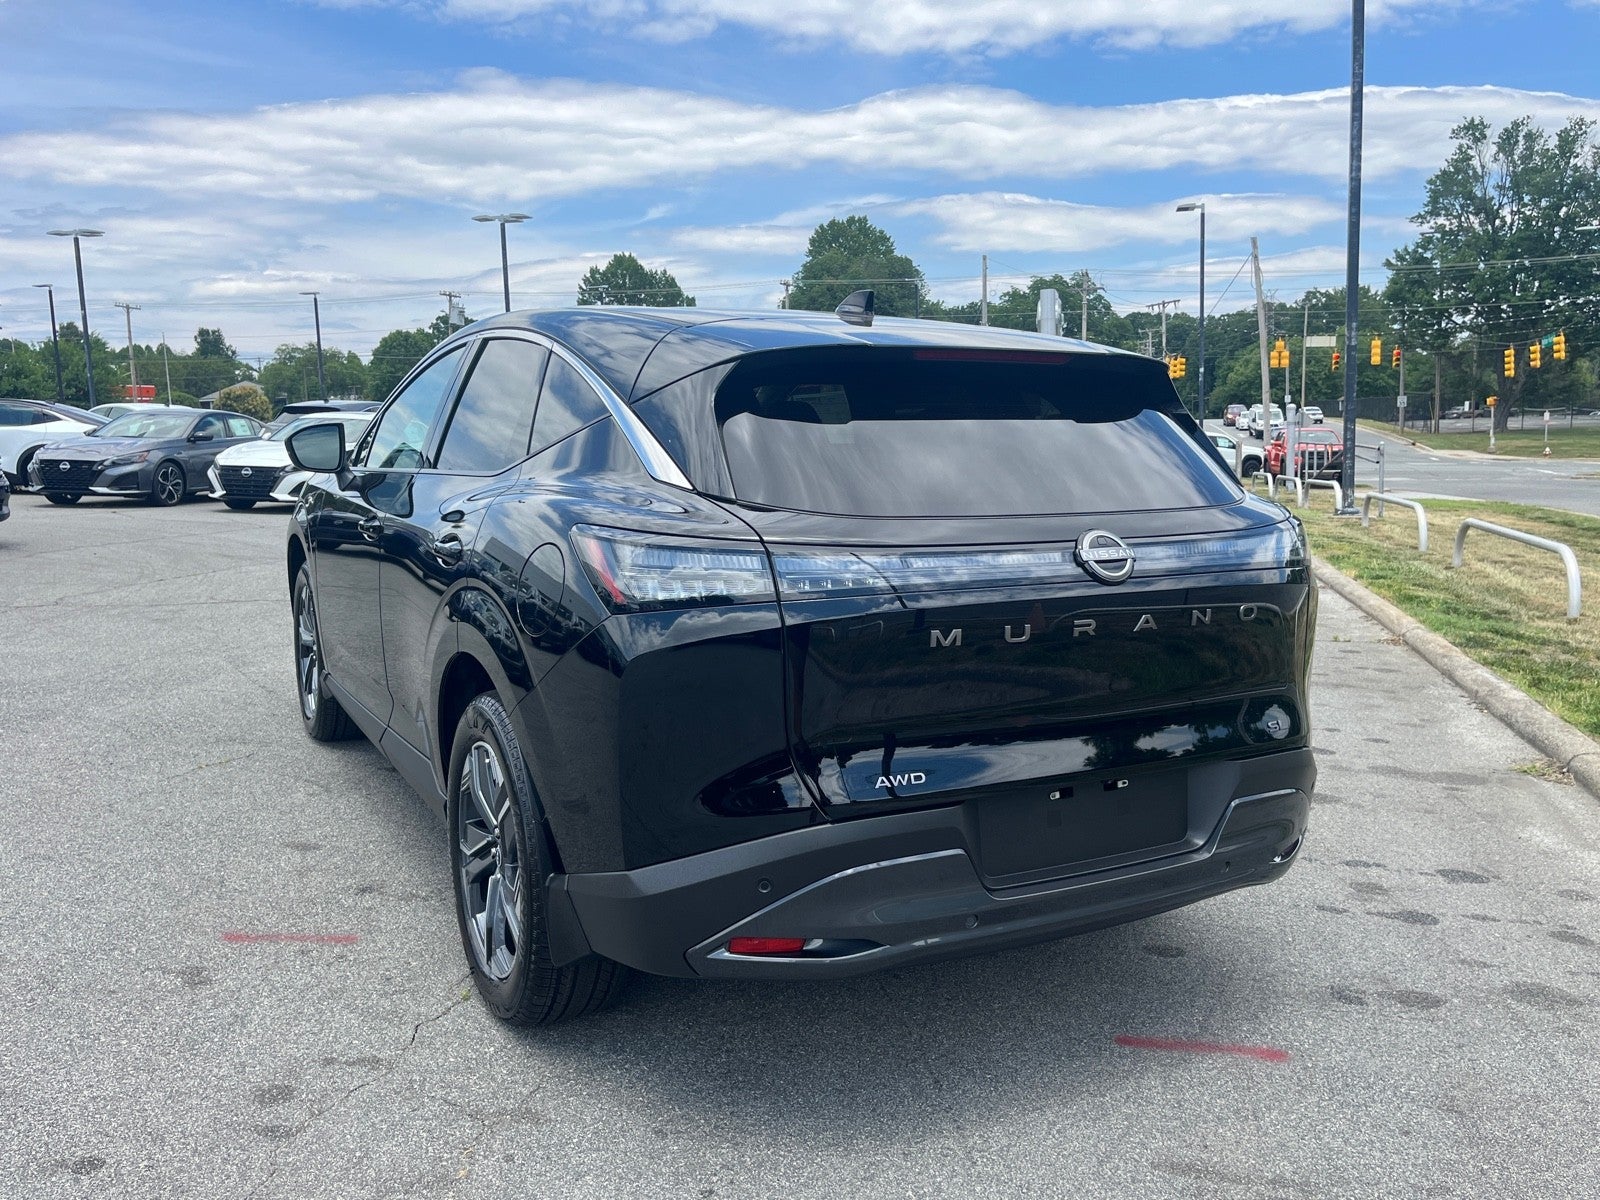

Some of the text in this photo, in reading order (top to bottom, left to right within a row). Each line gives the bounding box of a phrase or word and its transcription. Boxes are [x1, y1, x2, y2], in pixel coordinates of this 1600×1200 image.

[1083, 548, 1135, 560] NISSAN
[930, 604, 1258, 648] MURANO
[874, 772, 926, 789] AWD
